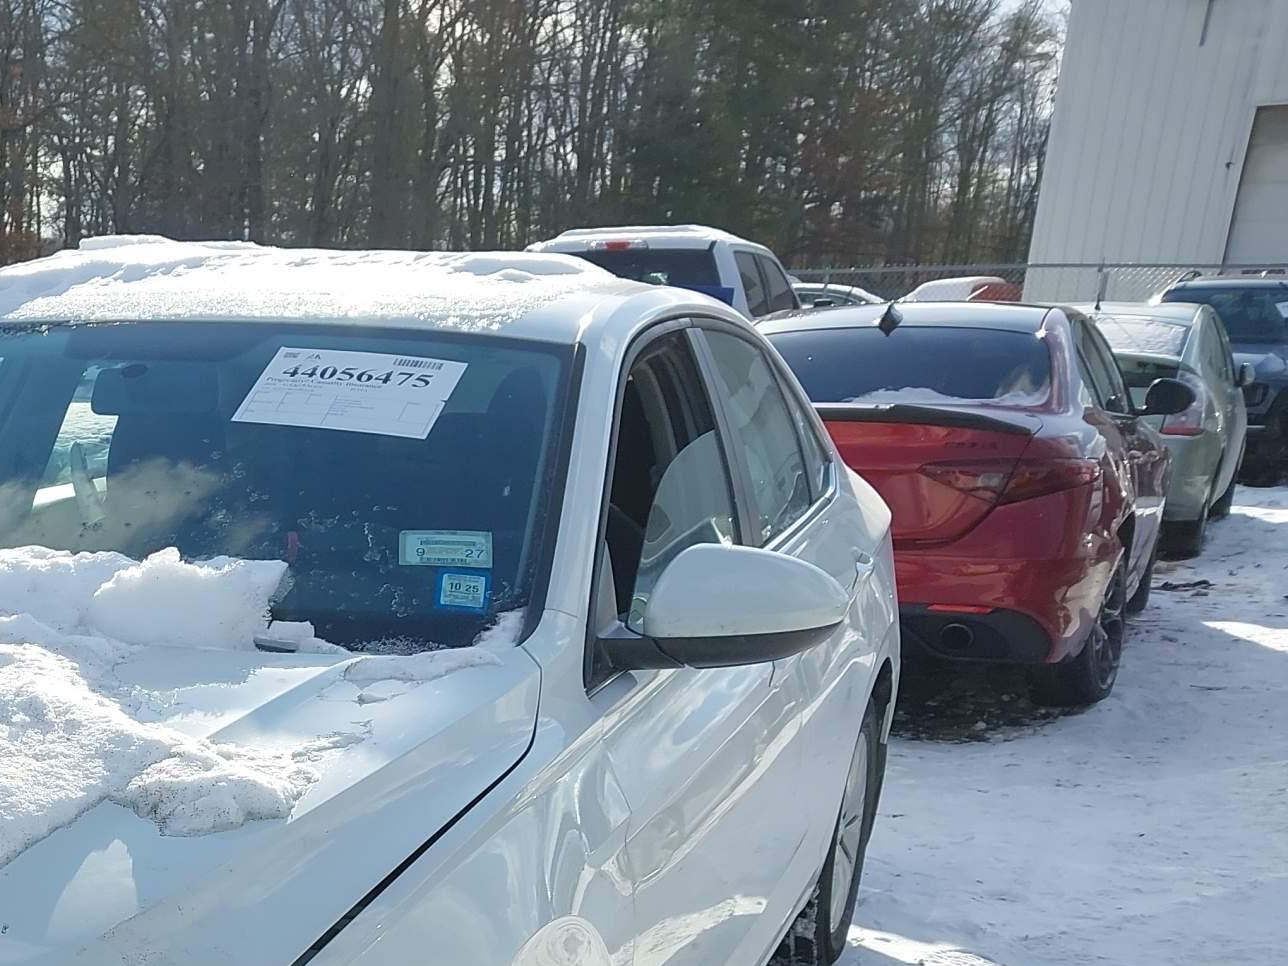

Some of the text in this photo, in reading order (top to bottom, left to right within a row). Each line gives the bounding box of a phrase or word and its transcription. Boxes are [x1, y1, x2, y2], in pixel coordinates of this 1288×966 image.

[281, 363, 434, 389] 44056475
[416, 547, 484, 559] 9 27
[449, 582, 479, 593] 10 25
